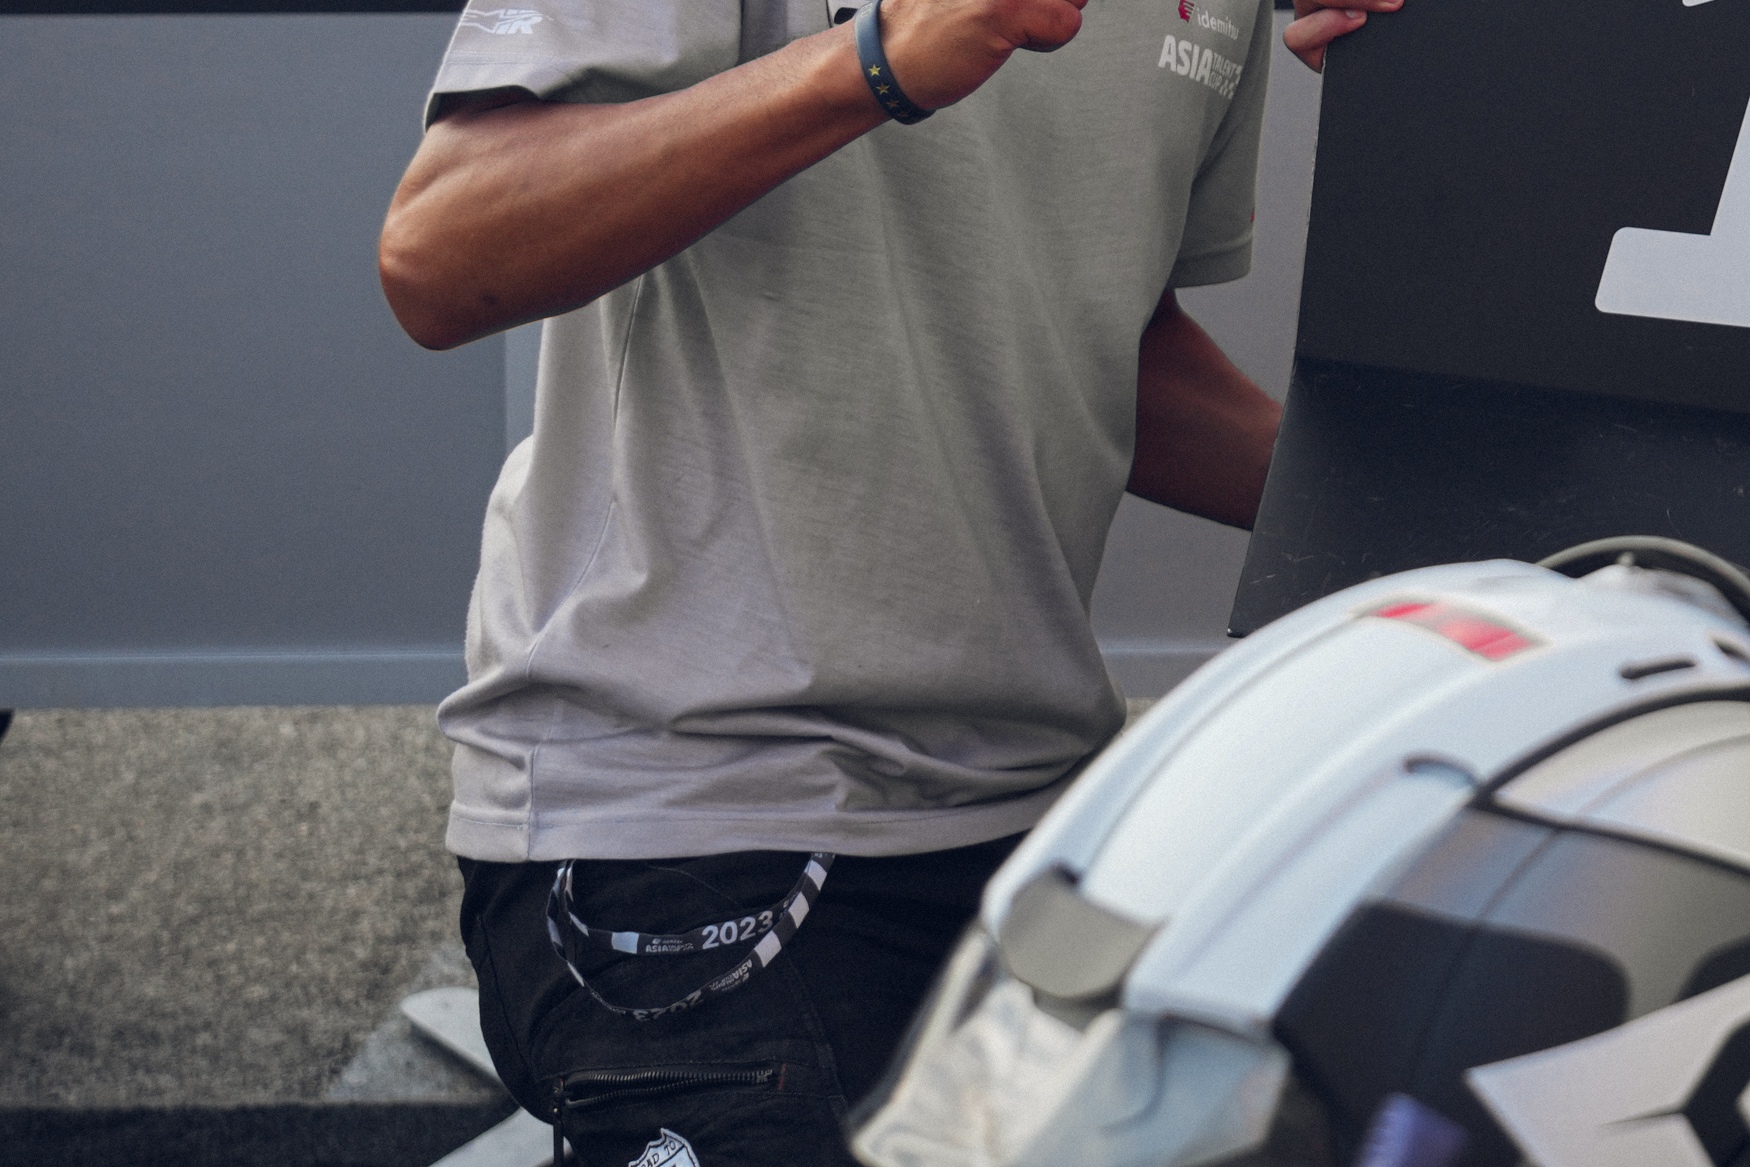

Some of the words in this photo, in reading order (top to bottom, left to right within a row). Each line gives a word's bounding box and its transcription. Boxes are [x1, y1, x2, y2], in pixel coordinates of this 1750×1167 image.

[1197, 7, 1240, 41] idemitsu
[1158, 34, 1214, 86] ASIA
[702, 910, 773, 950] 2023
[664, 1139, 677, 1156] TO
